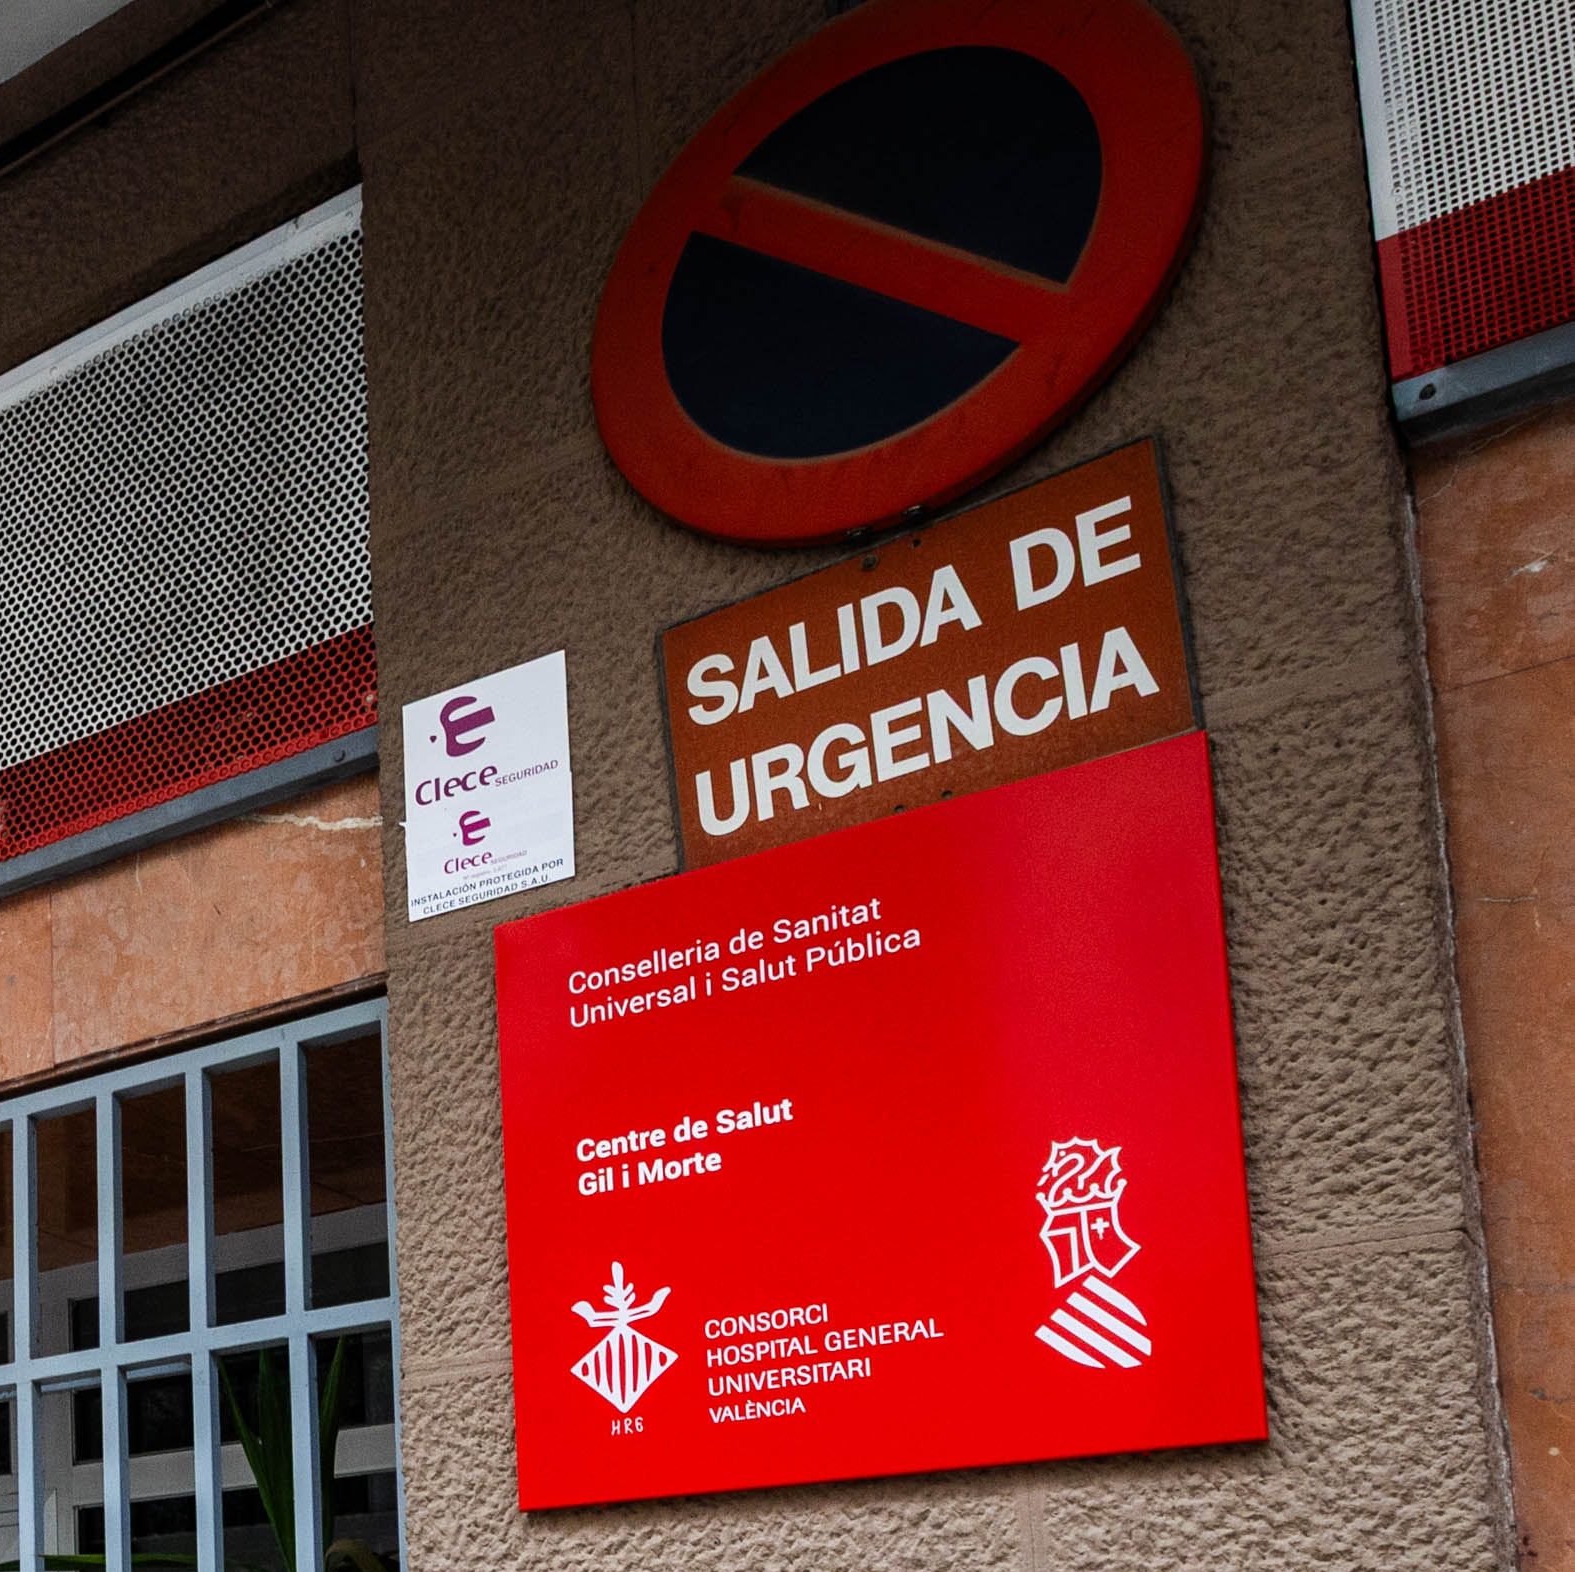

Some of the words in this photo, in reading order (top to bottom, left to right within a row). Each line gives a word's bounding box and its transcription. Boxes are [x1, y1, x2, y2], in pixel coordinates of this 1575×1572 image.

[684, 565, 982, 727] SALIDA
[1008, 496, 1143, 613] DE
[694, 626, 1160, 838] URGENCIA
[415, 765, 498, 806] Clece
[495, 759, 559, 788] SEGURIDAD
[411, 882, 477, 907] INSTALACIÓN
[479, 865, 539, 889] PROTEGIDA
[541, 858, 564, 871] POR
[444, 851, 492, 875] Clece
[422, 900, 455, 915] CLECE
[457, 883, 518, 906] SEGURIDAD
[521, 874, 551, 889] S.A.U.
[568, 939, 720, 995] Conselleria
[728, 928, 764, 955] de
[773, 898, 882, 943] Sanitat
[569, 975, 696, 1028] Universal
[705, 972, 713, 997] i
[721, 955, 797, 992] Salut
[805, 928, 922, 973] Pública
[576, 1128, 666, 1162] Centre
[673, 1116, 709, 1143] de
[716, 1098, 794, 1134] Salut
[578, 1166, 614, 1196] Gil
[621, 1163, 630, 1189] i
[637, 1152, 722, 1186] Morte
[704, 1303, 829, 1340] CONSORCI
[706, 1334, 819, 1368] HOSPITAL
[823, 1318, 945, 1353] GENERAL
[707, 1357, 872, 1397] UNIVERSITARI
[709, 1397, 807, 1424] VALÈNCIA
